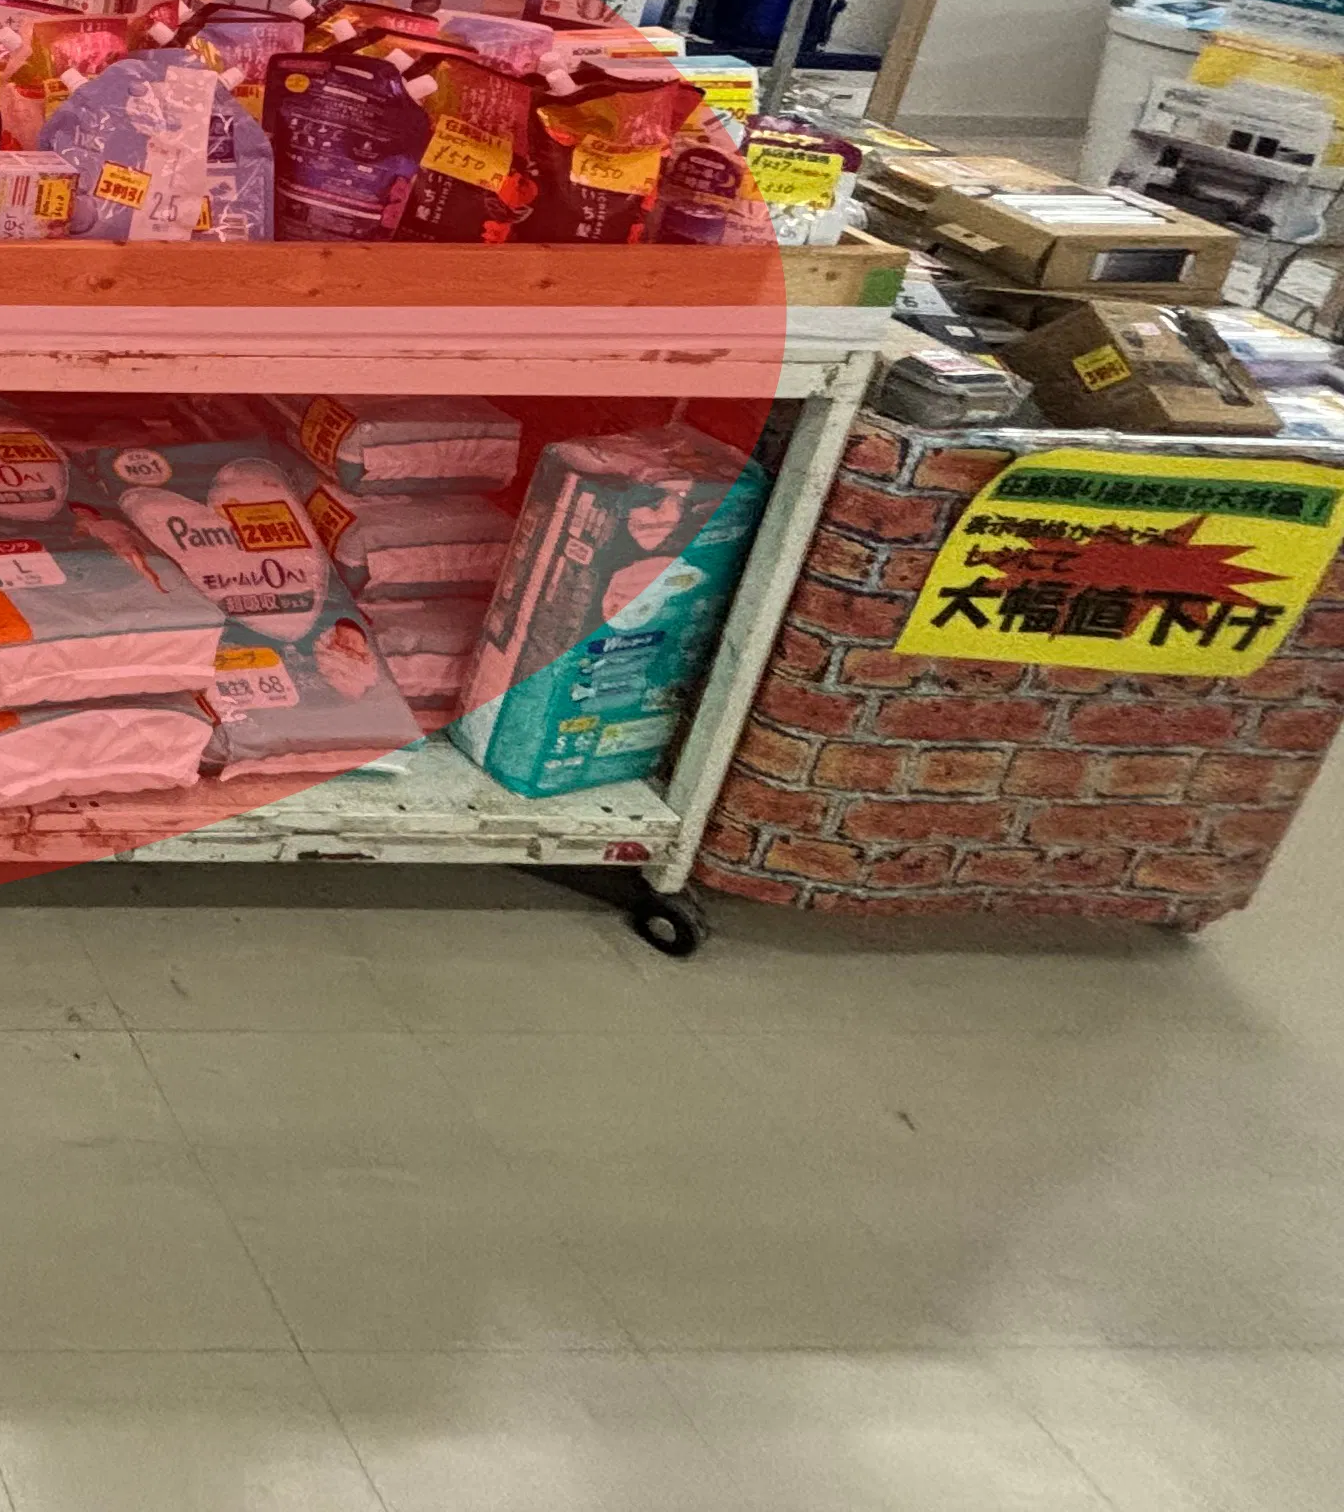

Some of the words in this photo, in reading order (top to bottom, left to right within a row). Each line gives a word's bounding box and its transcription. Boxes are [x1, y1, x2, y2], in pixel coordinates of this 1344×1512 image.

[930, 576, 1285, 652] 大幅値下げ
